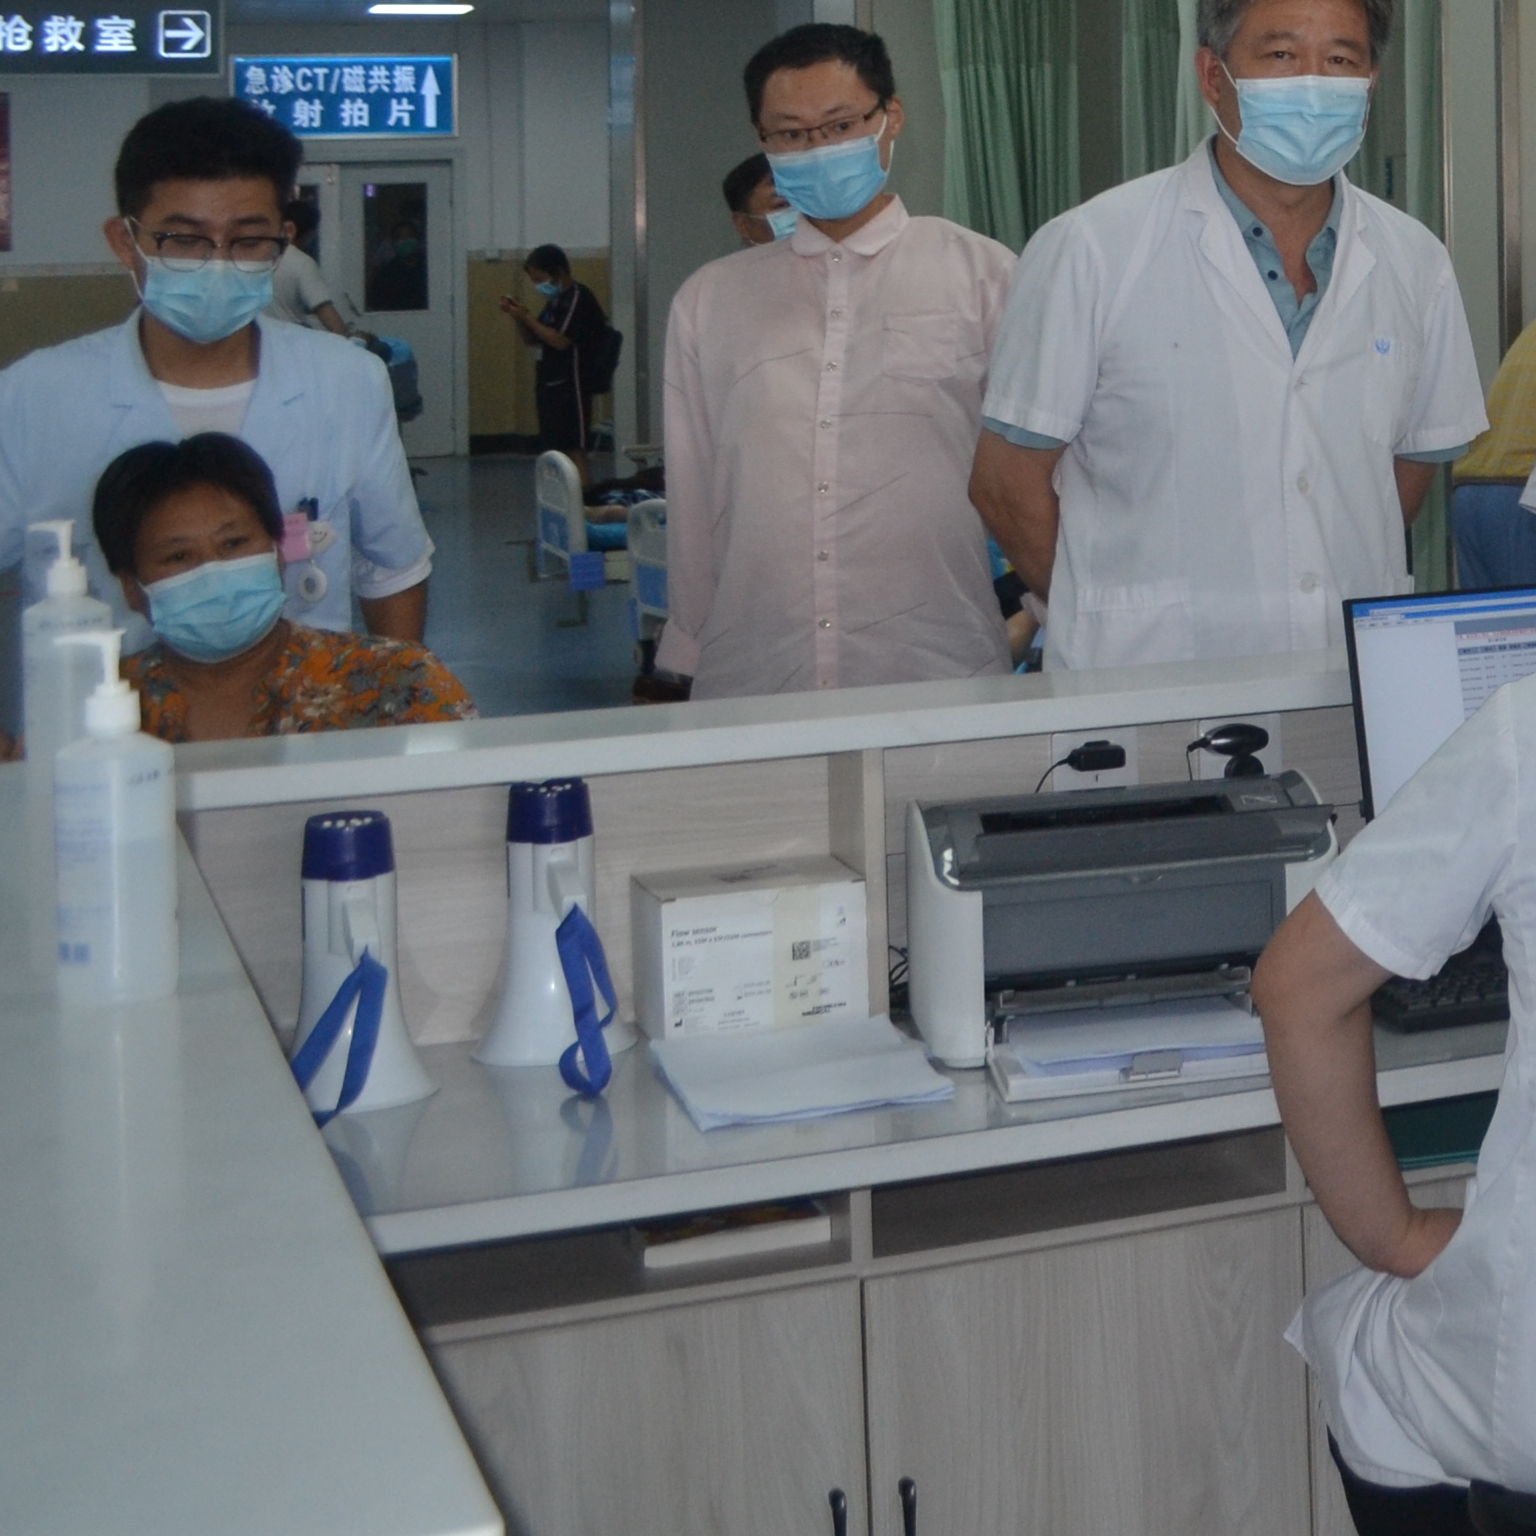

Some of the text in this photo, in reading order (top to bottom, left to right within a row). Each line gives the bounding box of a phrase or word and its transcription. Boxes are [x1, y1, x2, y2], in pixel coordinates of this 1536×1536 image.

[245, 65, 416, 95] 急诊CT/磁共振
